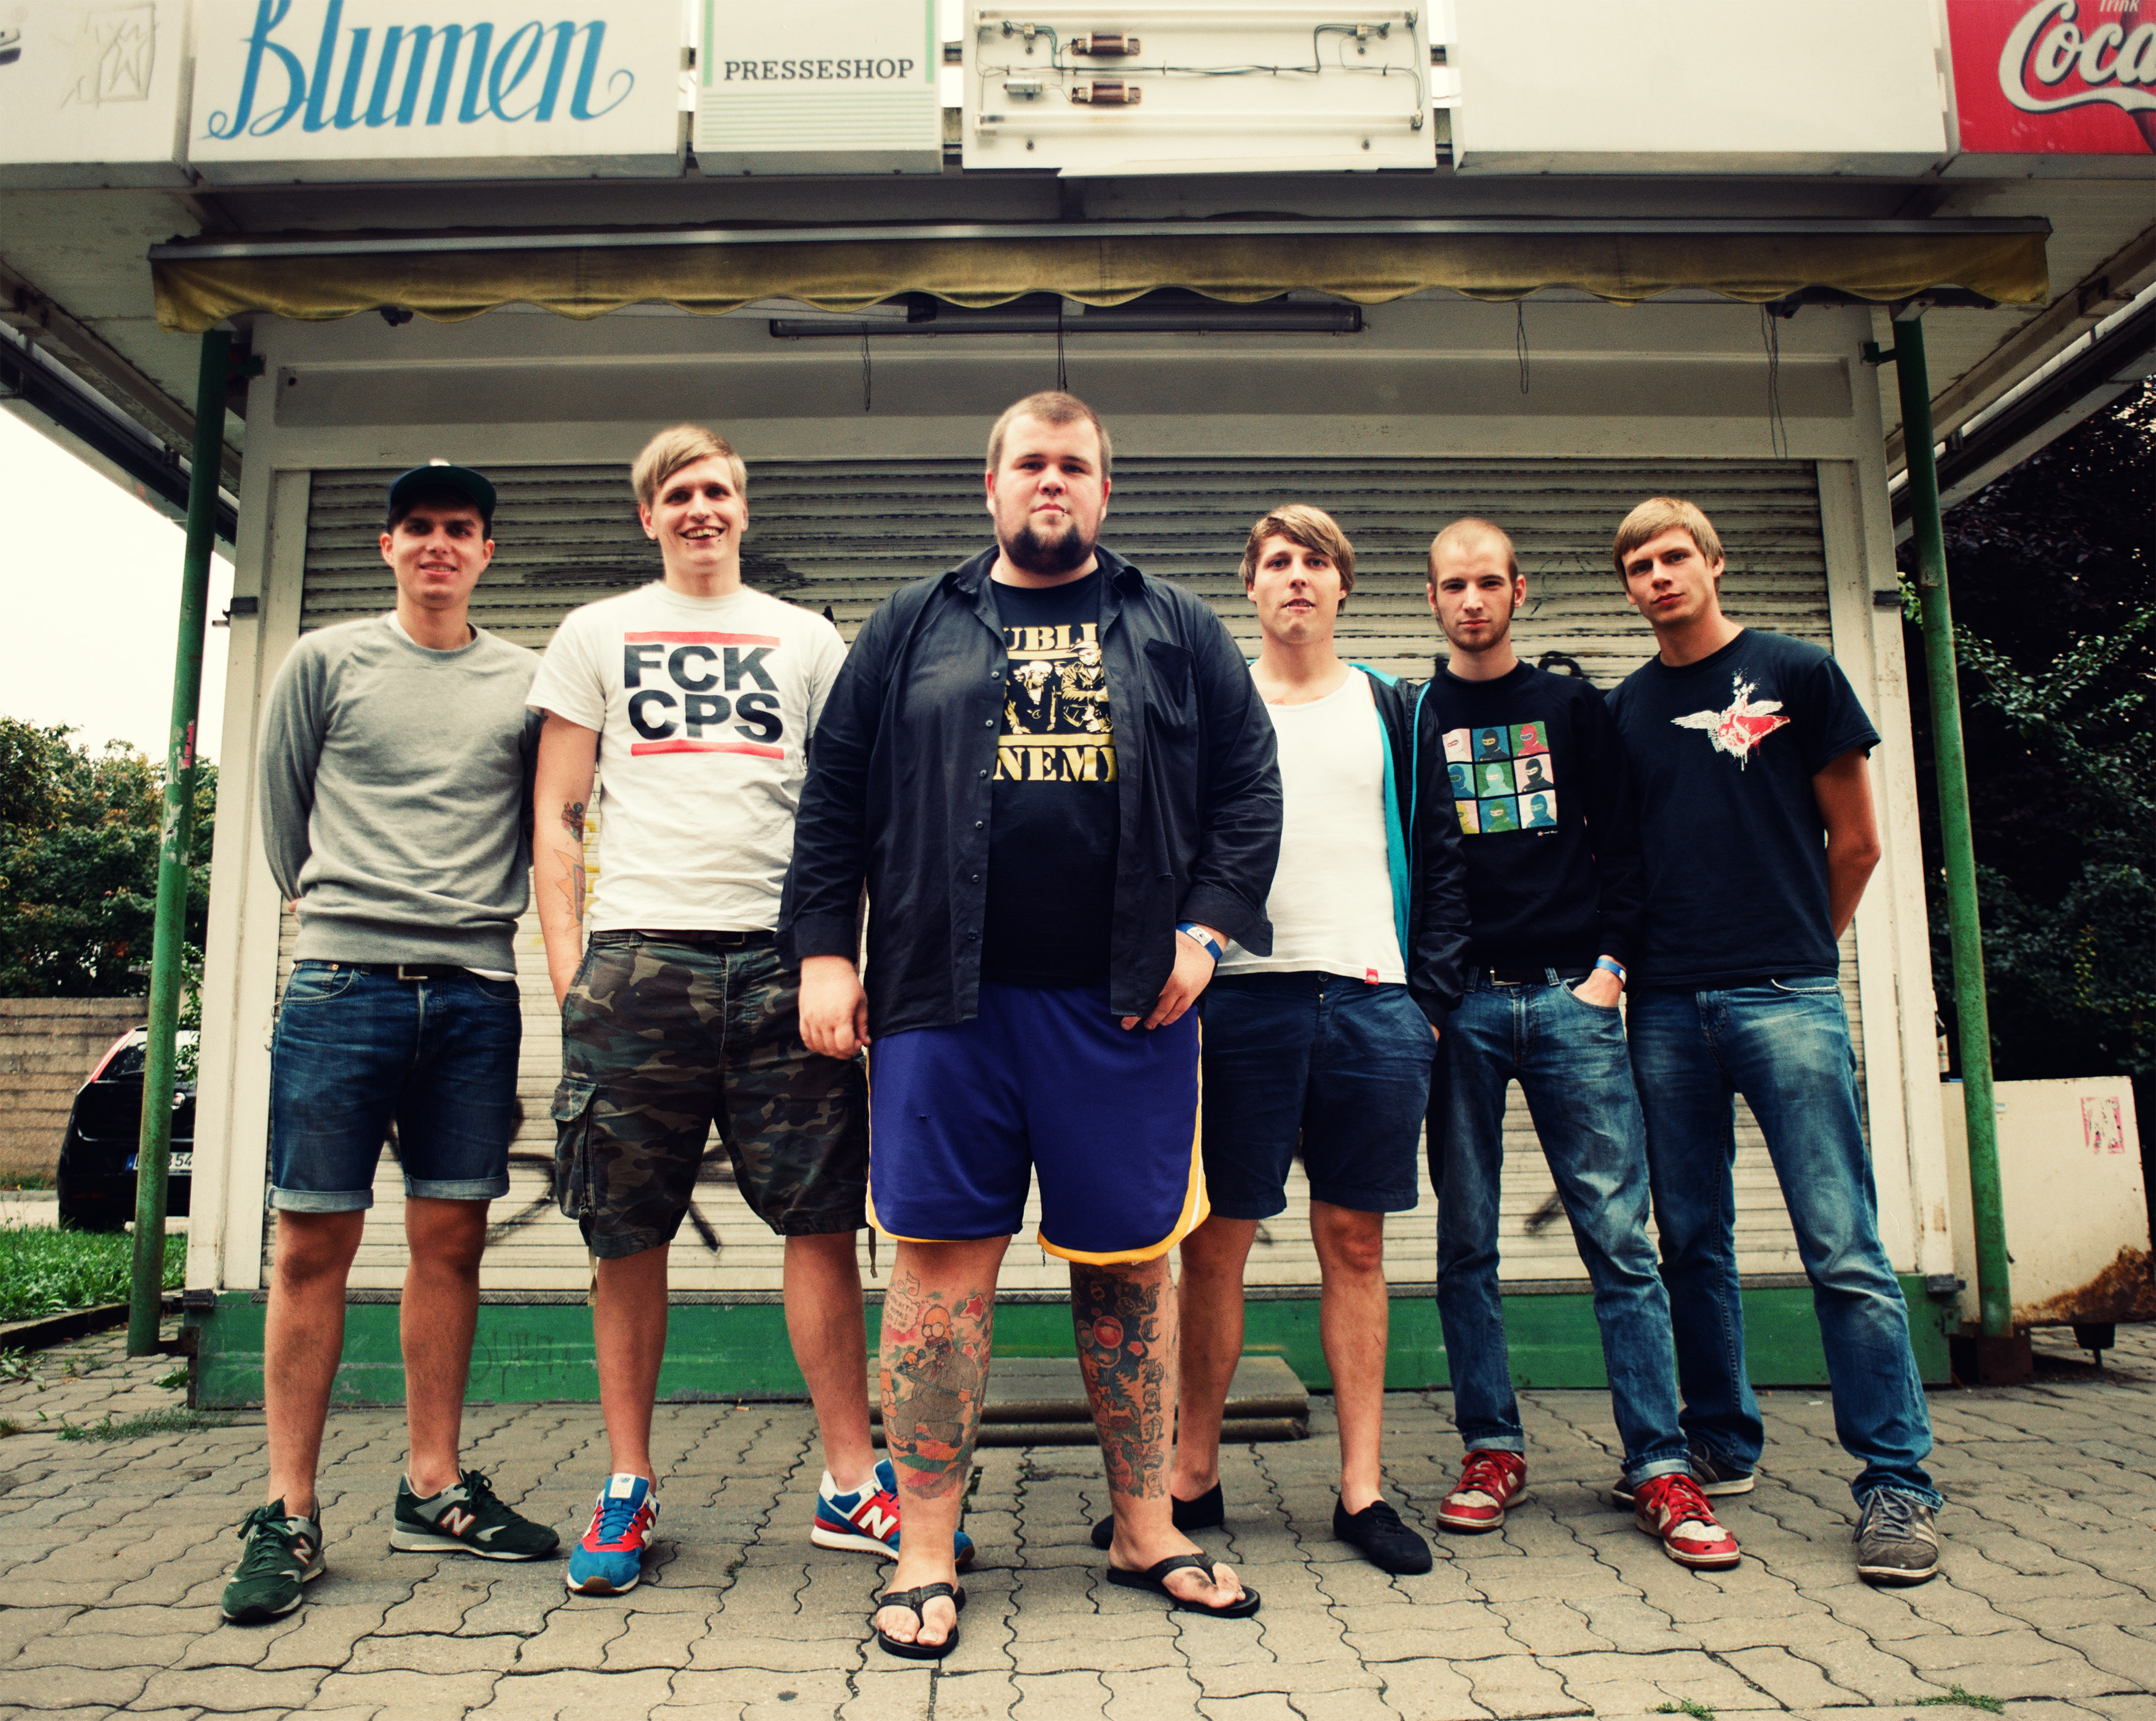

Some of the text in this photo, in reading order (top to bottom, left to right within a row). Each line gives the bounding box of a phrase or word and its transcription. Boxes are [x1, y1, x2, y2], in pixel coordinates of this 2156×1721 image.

[197, 0, 634, 140] Blumen
[724, 59, 914, 80] PRESSESHOP
[624, 644, 780, 692] FCK
[628, 689, 784, 744] CPS
[438, 1505, 476, 1536] N
[857, 1505, 898, 1540] N
